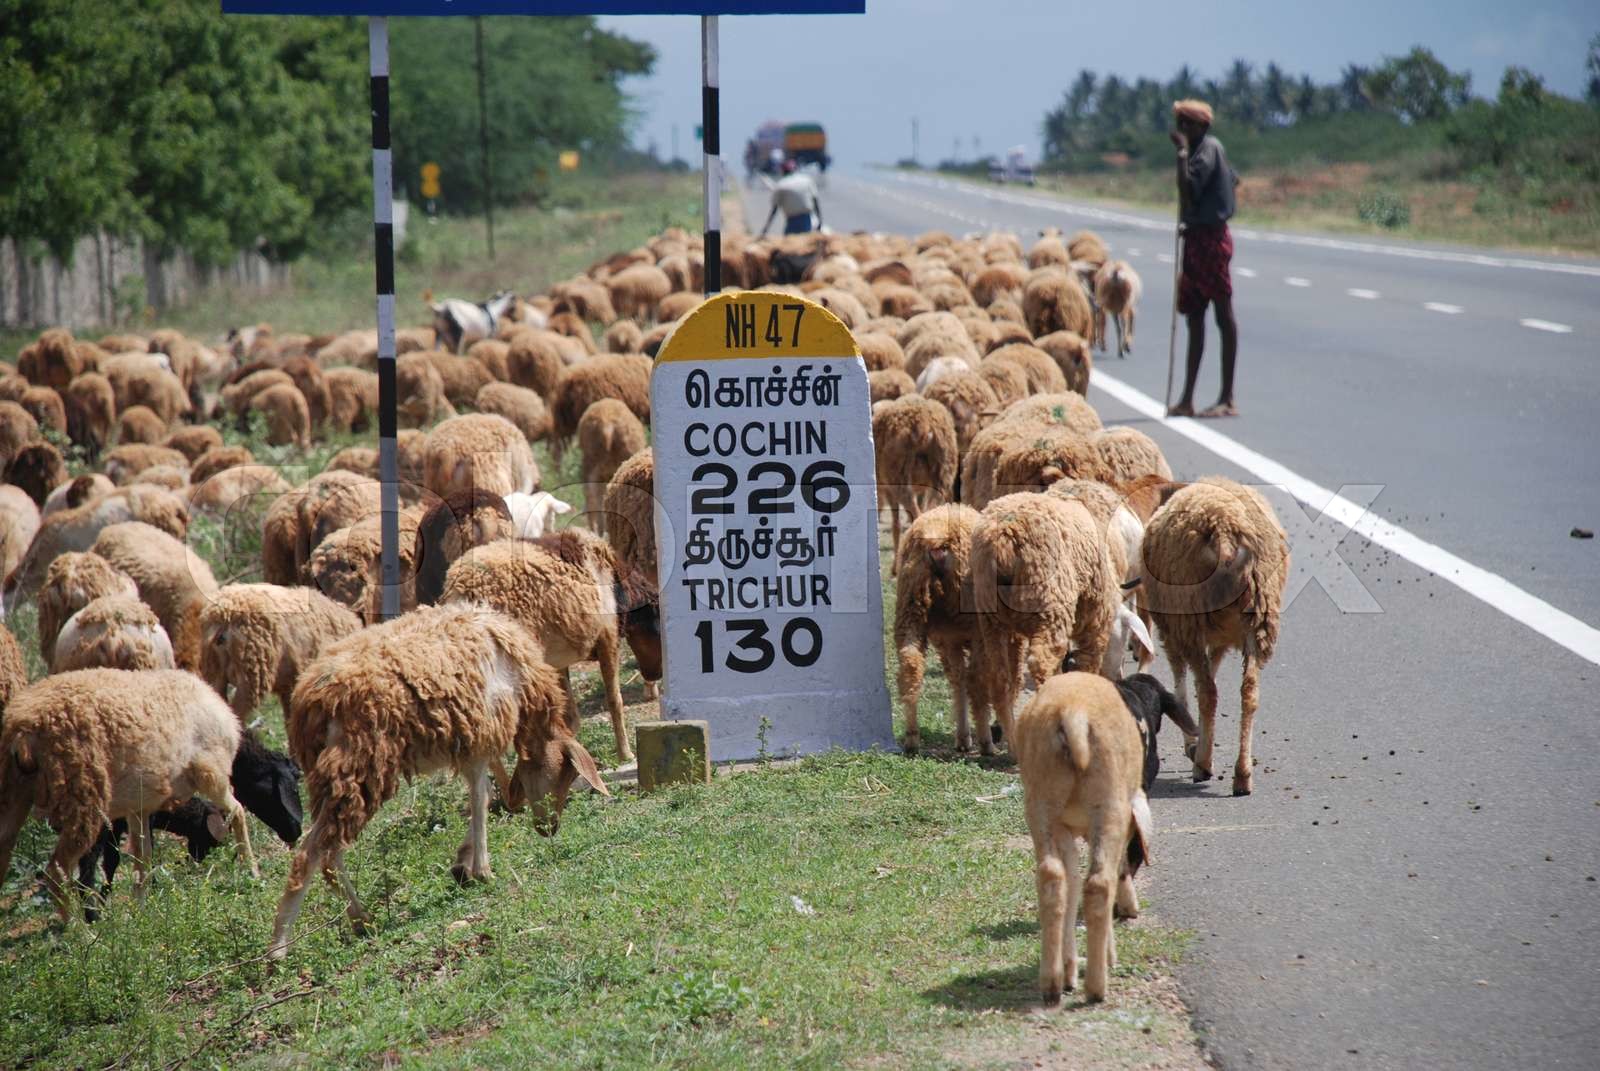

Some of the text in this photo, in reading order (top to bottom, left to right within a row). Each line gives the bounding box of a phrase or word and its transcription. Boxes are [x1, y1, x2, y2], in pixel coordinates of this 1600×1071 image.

[725, 303, 806, 348] NH 47
[685, 365, 842, 409] கொச்சின்
[683, 420, 827, 457] COCHIN
[691, 460, 851, 514] 226
[682, 515, 838, 571] திருச்சூர்
[681, 574, 832, 611] TRICHUR
[694, 616, 823, 674] 130
